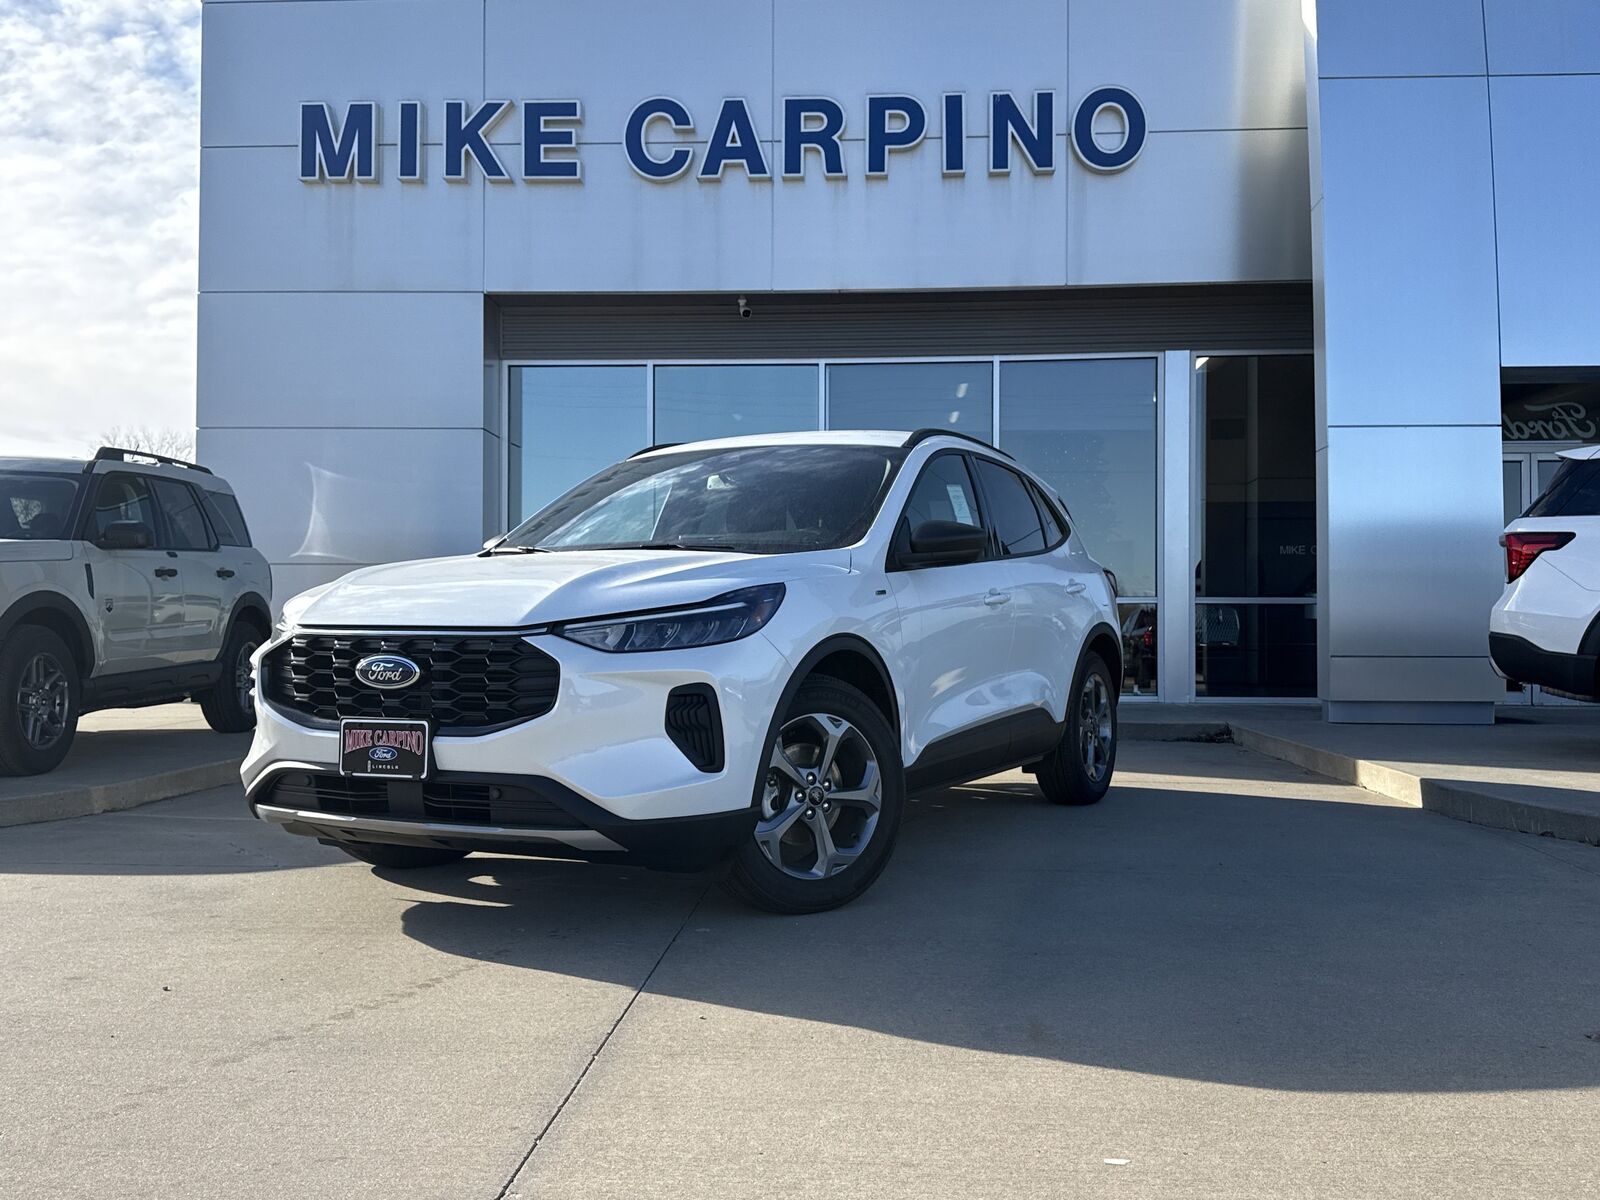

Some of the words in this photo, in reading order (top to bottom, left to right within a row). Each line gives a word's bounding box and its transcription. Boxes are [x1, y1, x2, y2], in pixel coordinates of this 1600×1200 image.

[299, 100, 583, 184] MIKE
[623, 85, 1149, 183] CARPINO
[1280, 545, 1306, 555] MIKE
[368, 662, 402, 680] Ford
[344, 730, 372, 754] MIKE
[374, 730, 424, 755] CARPINO
[374, 748, 392, 758] Ford
